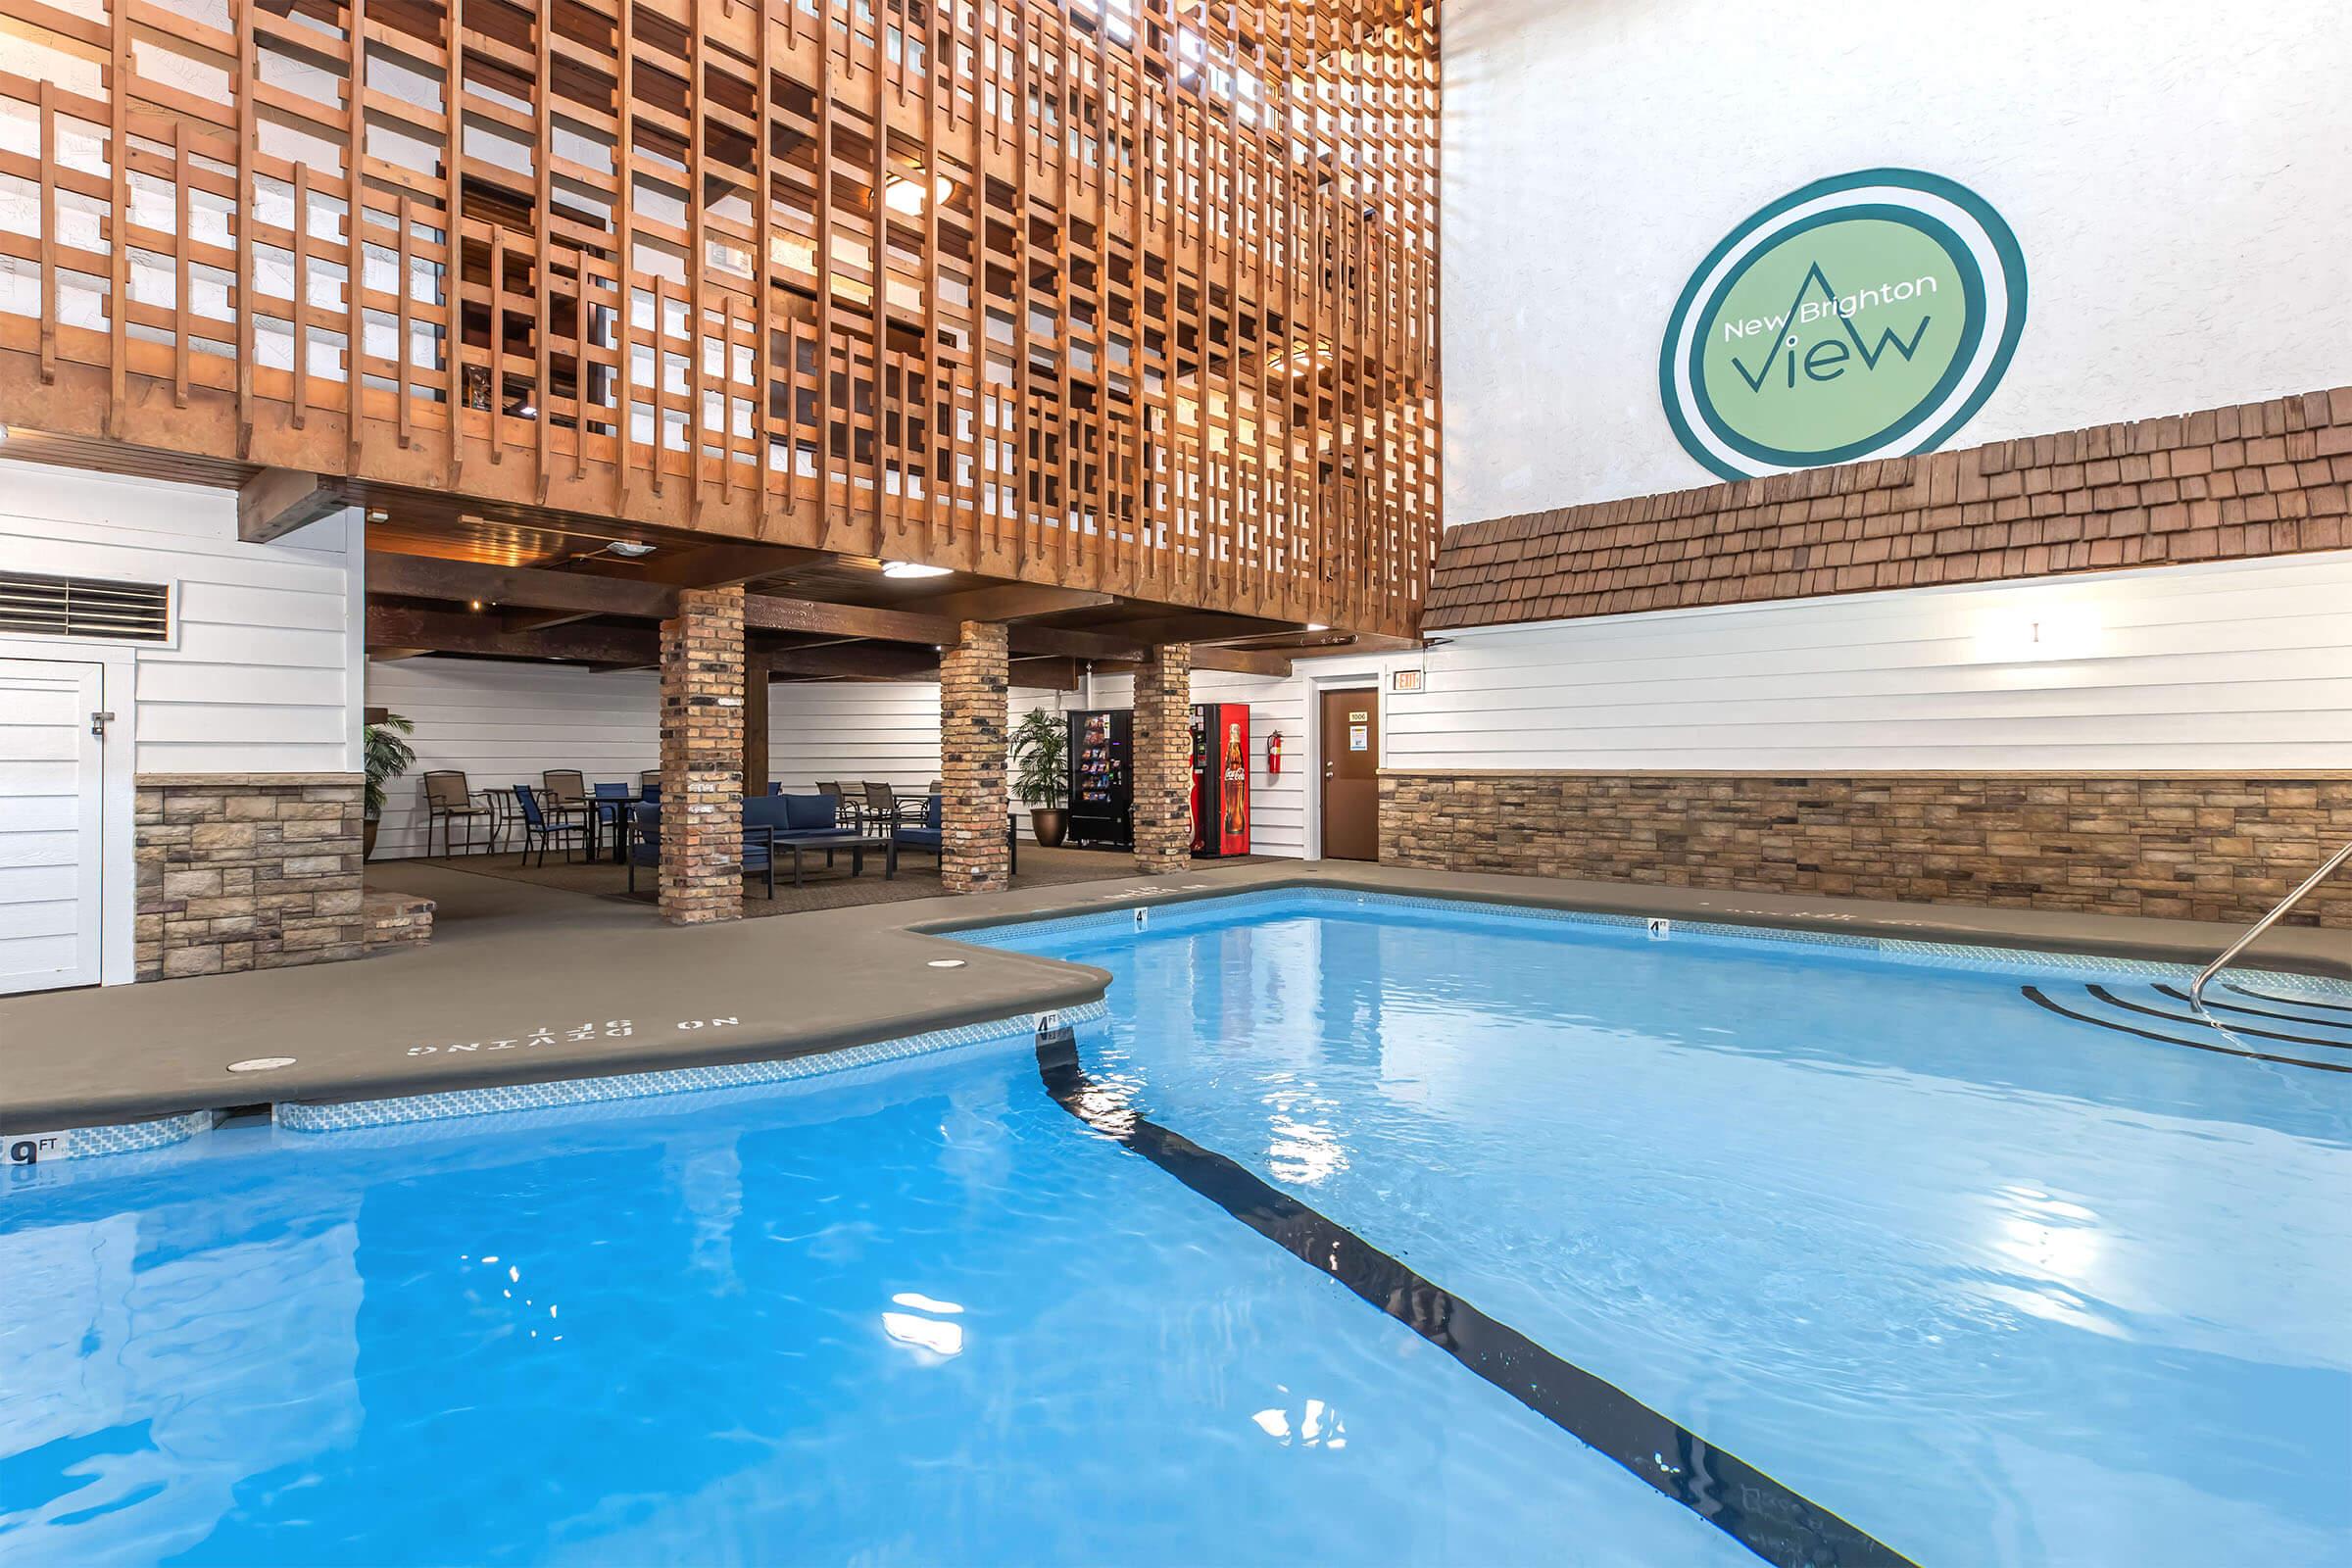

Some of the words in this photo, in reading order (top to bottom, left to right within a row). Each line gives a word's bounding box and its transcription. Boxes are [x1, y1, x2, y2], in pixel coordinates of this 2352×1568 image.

[1724, 311, 1791, 343] New
[1800, 275, 1937, 324] Brighton
[1399, 673, 1417, 688] EXIT
[677, 1016, 739, 1030] NO
[407, 1026, 632, 1056] DIVING
